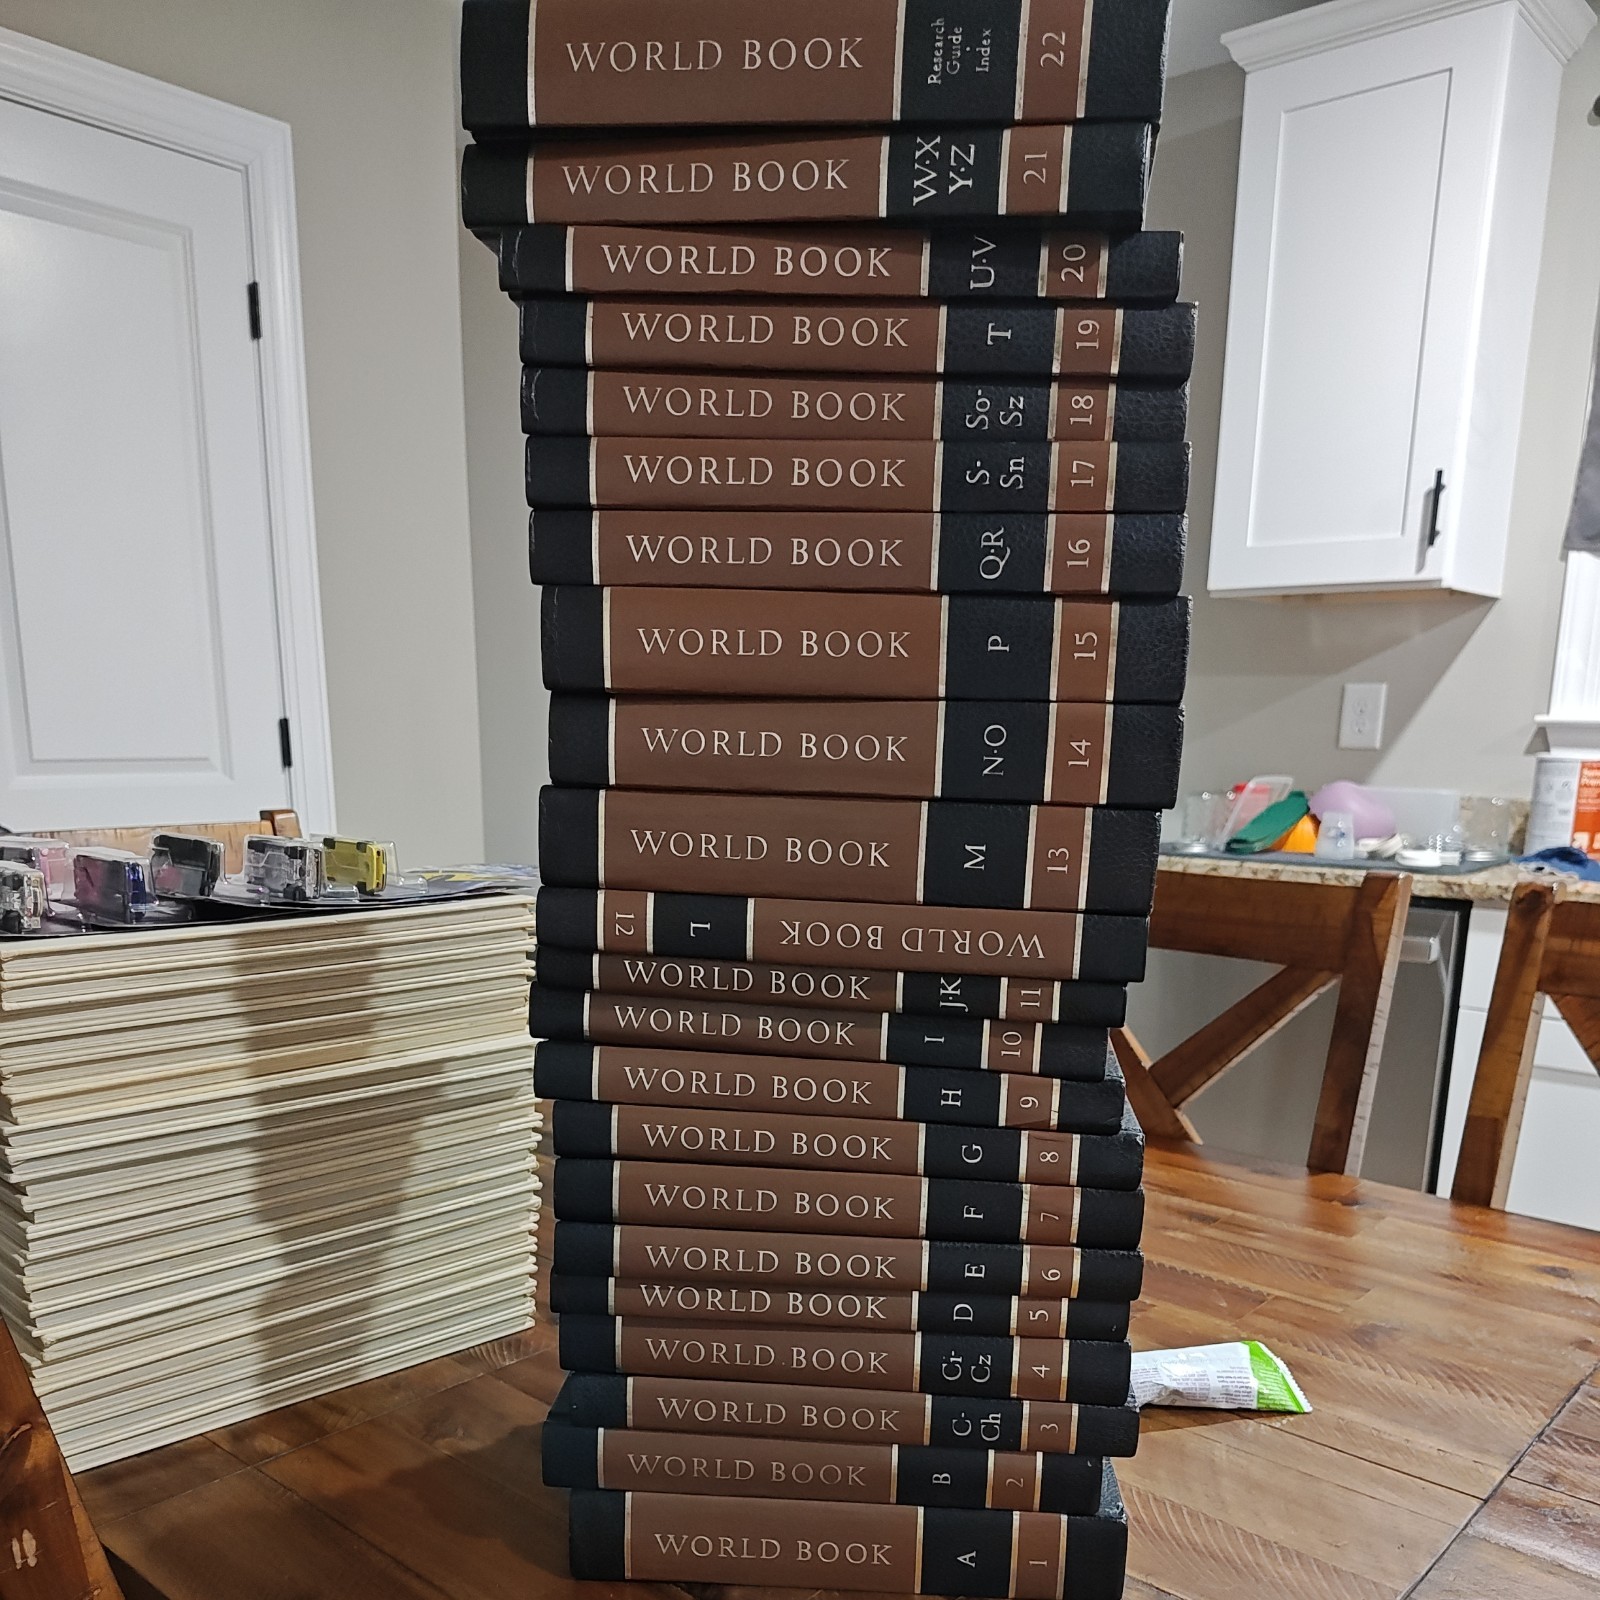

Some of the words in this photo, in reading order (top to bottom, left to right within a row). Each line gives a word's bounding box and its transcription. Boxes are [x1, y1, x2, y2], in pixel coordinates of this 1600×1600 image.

[566, 39, 722, 74] WORLD
[743, 37, 863, 70] BOOK
[928, 17, 944, 85] Research
[947, 26, 962, 75] Guide
[976, 29, 991, 73] Index
[1040, 31, 1066, 67] 22
[561, 163, 714, 195] WORLD
[732, 159, 849, 192] BOOK
[1023, 150, 1047, 184] 21
[601, 244, 756, 275] WORLD
[774, 246, 892, 278] BOOK
[1060, 244, 1086, 282] 20
[622, 312, 773, 344] WORLD
[793, 317, 909, 347] BOOK
[987, 323, 1011, 345] T
[1076, 320, 1099, 350] 19
[622, 386, 772, 418] WORLD
[791, 391, 906, 422] BOOK
[1000, 395, 1024, 427] Sz
[1070, 395, 1094, 425] 18
[624, 454, 773, 485] WORLD
[791, 458, 906, 488] BOOK
[1000, 457, 1024, 489] Sn
[1071, 460, 1095, 488] 17
[626, 534, 772, 564] WORLD
[790, 538, 903, 567] BOOK
[1066, 539, 1091, 568] 16
[637, 628, 783, 657] WORLD
[800, 630, 911, 658] BOOK
[988, 635, 1010, 652] P
[1074, 631, 1098, 661] 15
[641, 728, 782, 758] WORLD
[800, 732, 907, 762] BOOK
[1068, 738, 1092, 768] 14
[630, 829, 768, 860] WORLD
[786, 837, 890, 868] BOOK
[963, 845, 986, 870] M
[1047, 847, 1069, 874] 13
[615, 911, 635, 936] 12
[691, 921, 711, 937] L
[779, 919, 884, 950] BOOK
[901, 928, 1045, 959] WORLD
[623, 959, 753, 992] WORLD
[769, 970, 871, 1000] BOOK
[1020, 989, 1041, 1008] 11
[614, 1006, 741, 1036] WORLD
[757, 1016, 855, 1046] BOOK
[924, 1035, 944, 1043] I
[1001, 1031, 1022, 1058] 10
[623, 1066, 756, 1096] WORLD
[771, 1075, 872, 1105] BOOK
[941, 1088, 962, 1107] H
[1020, 1096, 1039, 1109] 9
[642, 1123, 775, 1153] WORLD
[791, 1132, 892, 1161] BOOK
[962, 1144, 983, 1164] G
[1039, 1151, 1059, 1163] 8
[644, 1184, 778, 1213] WORLD
[794, 1192, 895, 1220] BOOK
[963, 1205, 984, 1219] F
[1040, 1212, 1059, 1222] 7
[645, 1245, 779, 1273] WORLD
[796, 1252, 896, 1279] BOOK
[965, 1263, 985, 1278] E
[1041, 1269, 1061, 1281] 6
[640, 1285, 771, 1313] WORLD
[787, 1293, 887, 1319] BOOK
[953, 1303, 974, 1322] D
[1029, 1309, 1049, 1322] 5
[645, 1338, 775, 1366] WORLD
[791, 1347, 889, 1374] BOOK
[970, 1355, 992, 1383] Cz
[1032, 1364, 1050, 1379] 4
[657, 1397, 786, 1425] WORLD
[802, 1405, 900, 1431] BOOK
[980, 1412, 1001, 1441] Ch
[1040, 1422, 1059, 1433] 3
[627, 1453, 755, 1480] WORLD
[771, 1462, 866, 1487] BOOK
[932, 1472, 951, 1485] B
[1006, 1477, 1023, 1487] 2
[654, 1533, 781, 1560] WORLD
[796, 1541, 892, 1566] BOOK
[956, 1551, 977, 1567] A
